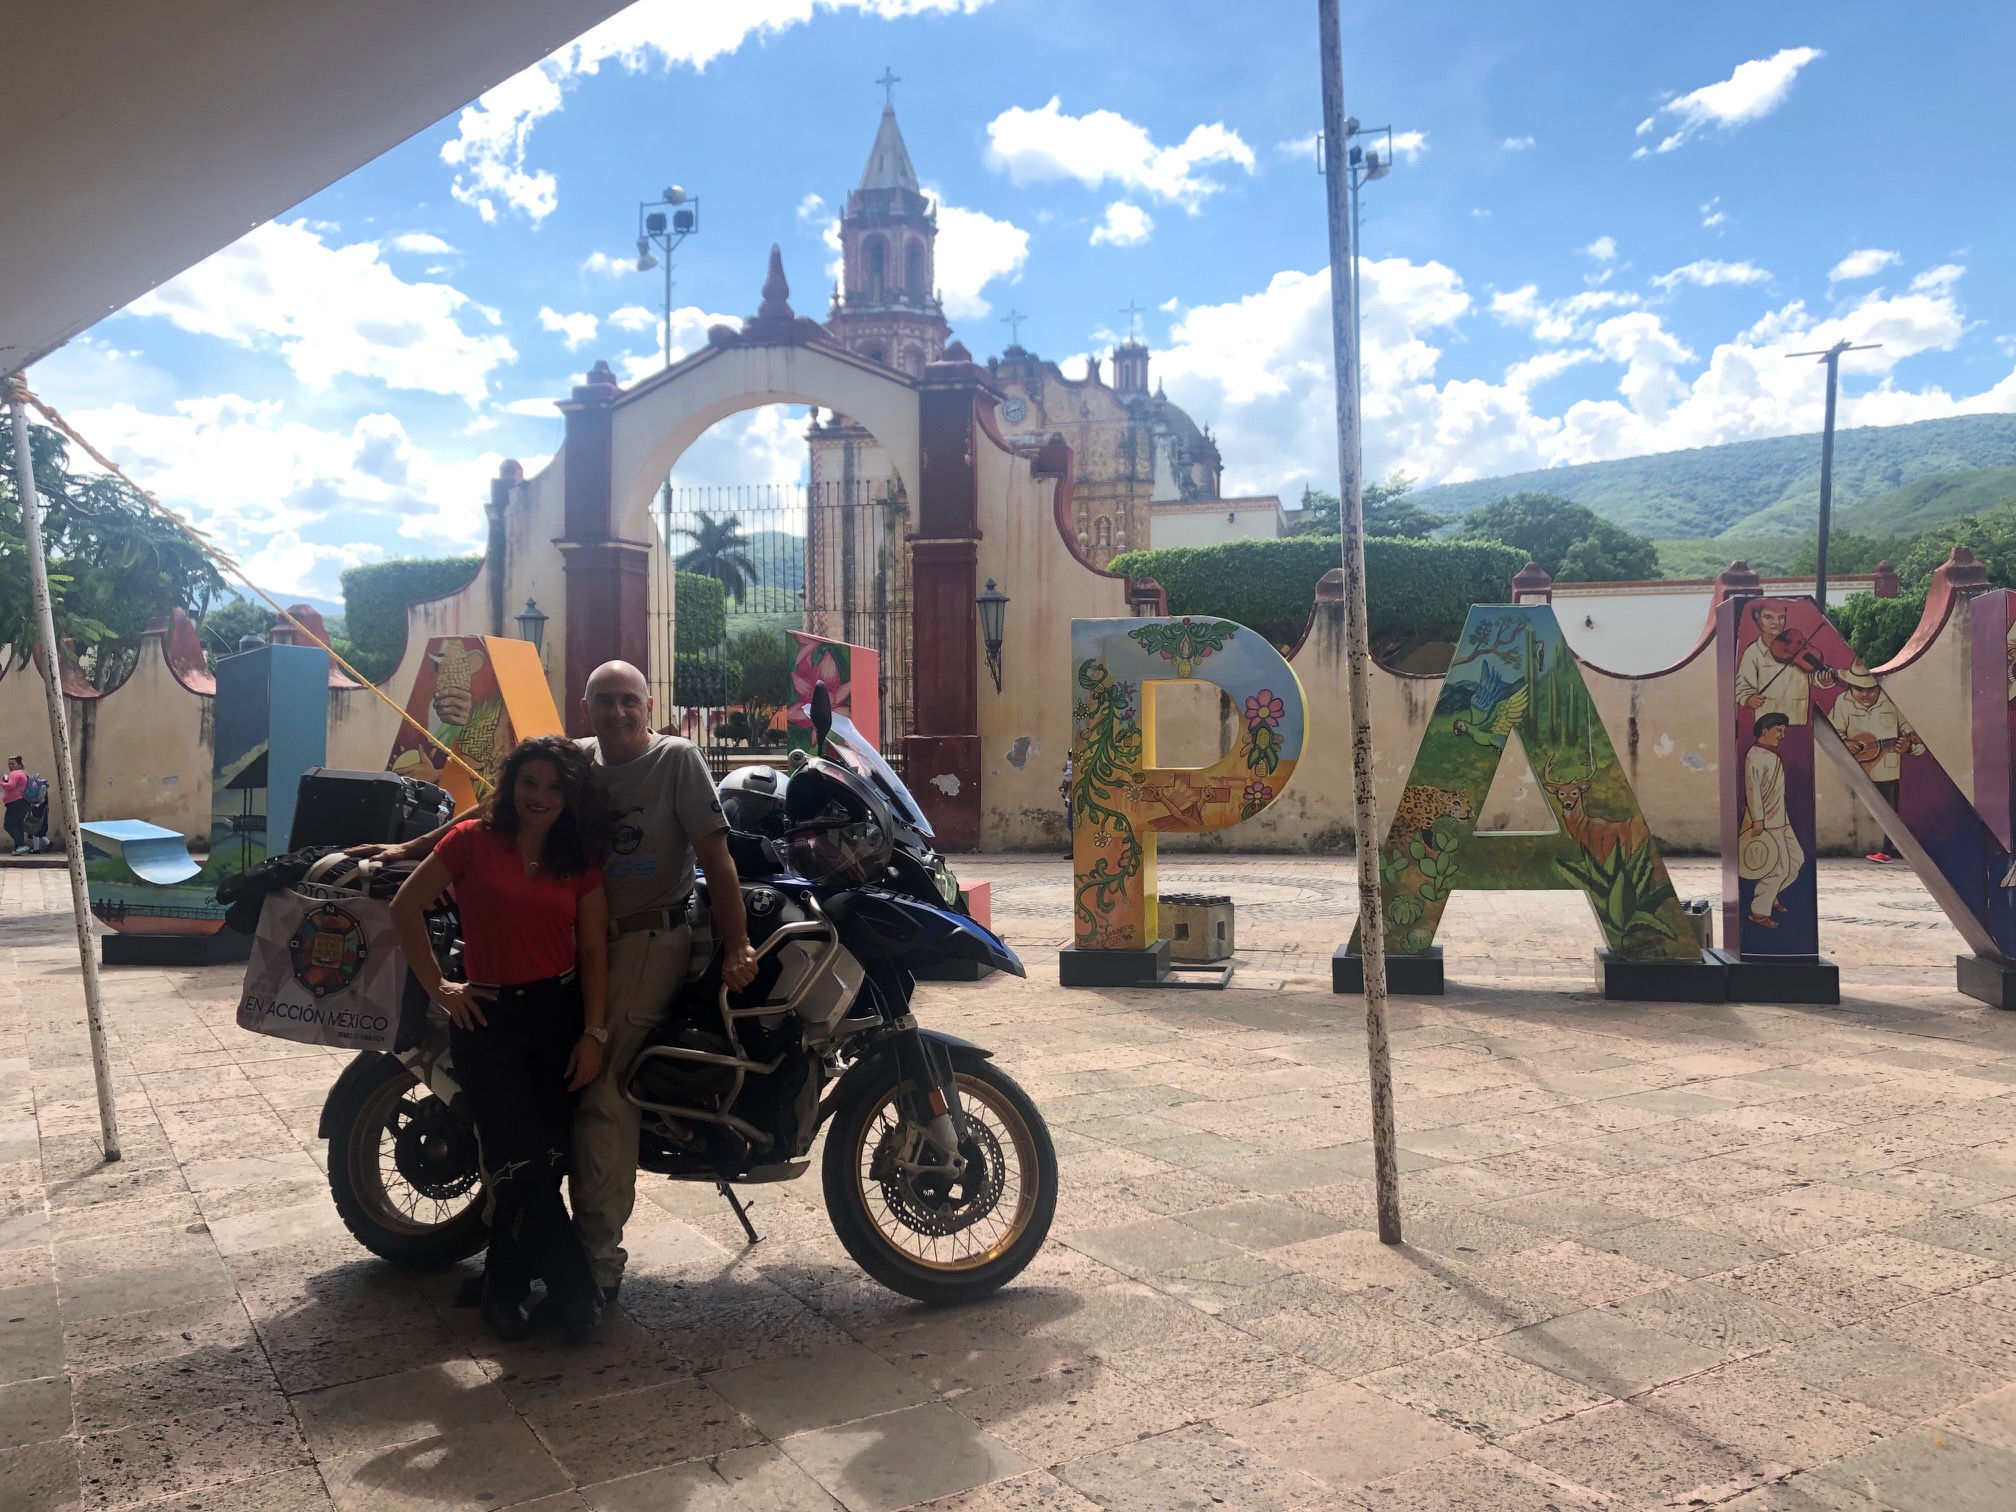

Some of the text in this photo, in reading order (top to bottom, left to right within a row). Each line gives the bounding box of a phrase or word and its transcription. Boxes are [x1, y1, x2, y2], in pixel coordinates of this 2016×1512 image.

[291, 881, 328, 899] OTO
[326, 905, 335, 914] N
[245, 995, 388, 1031] EN ACCIÓN MÉXICO
